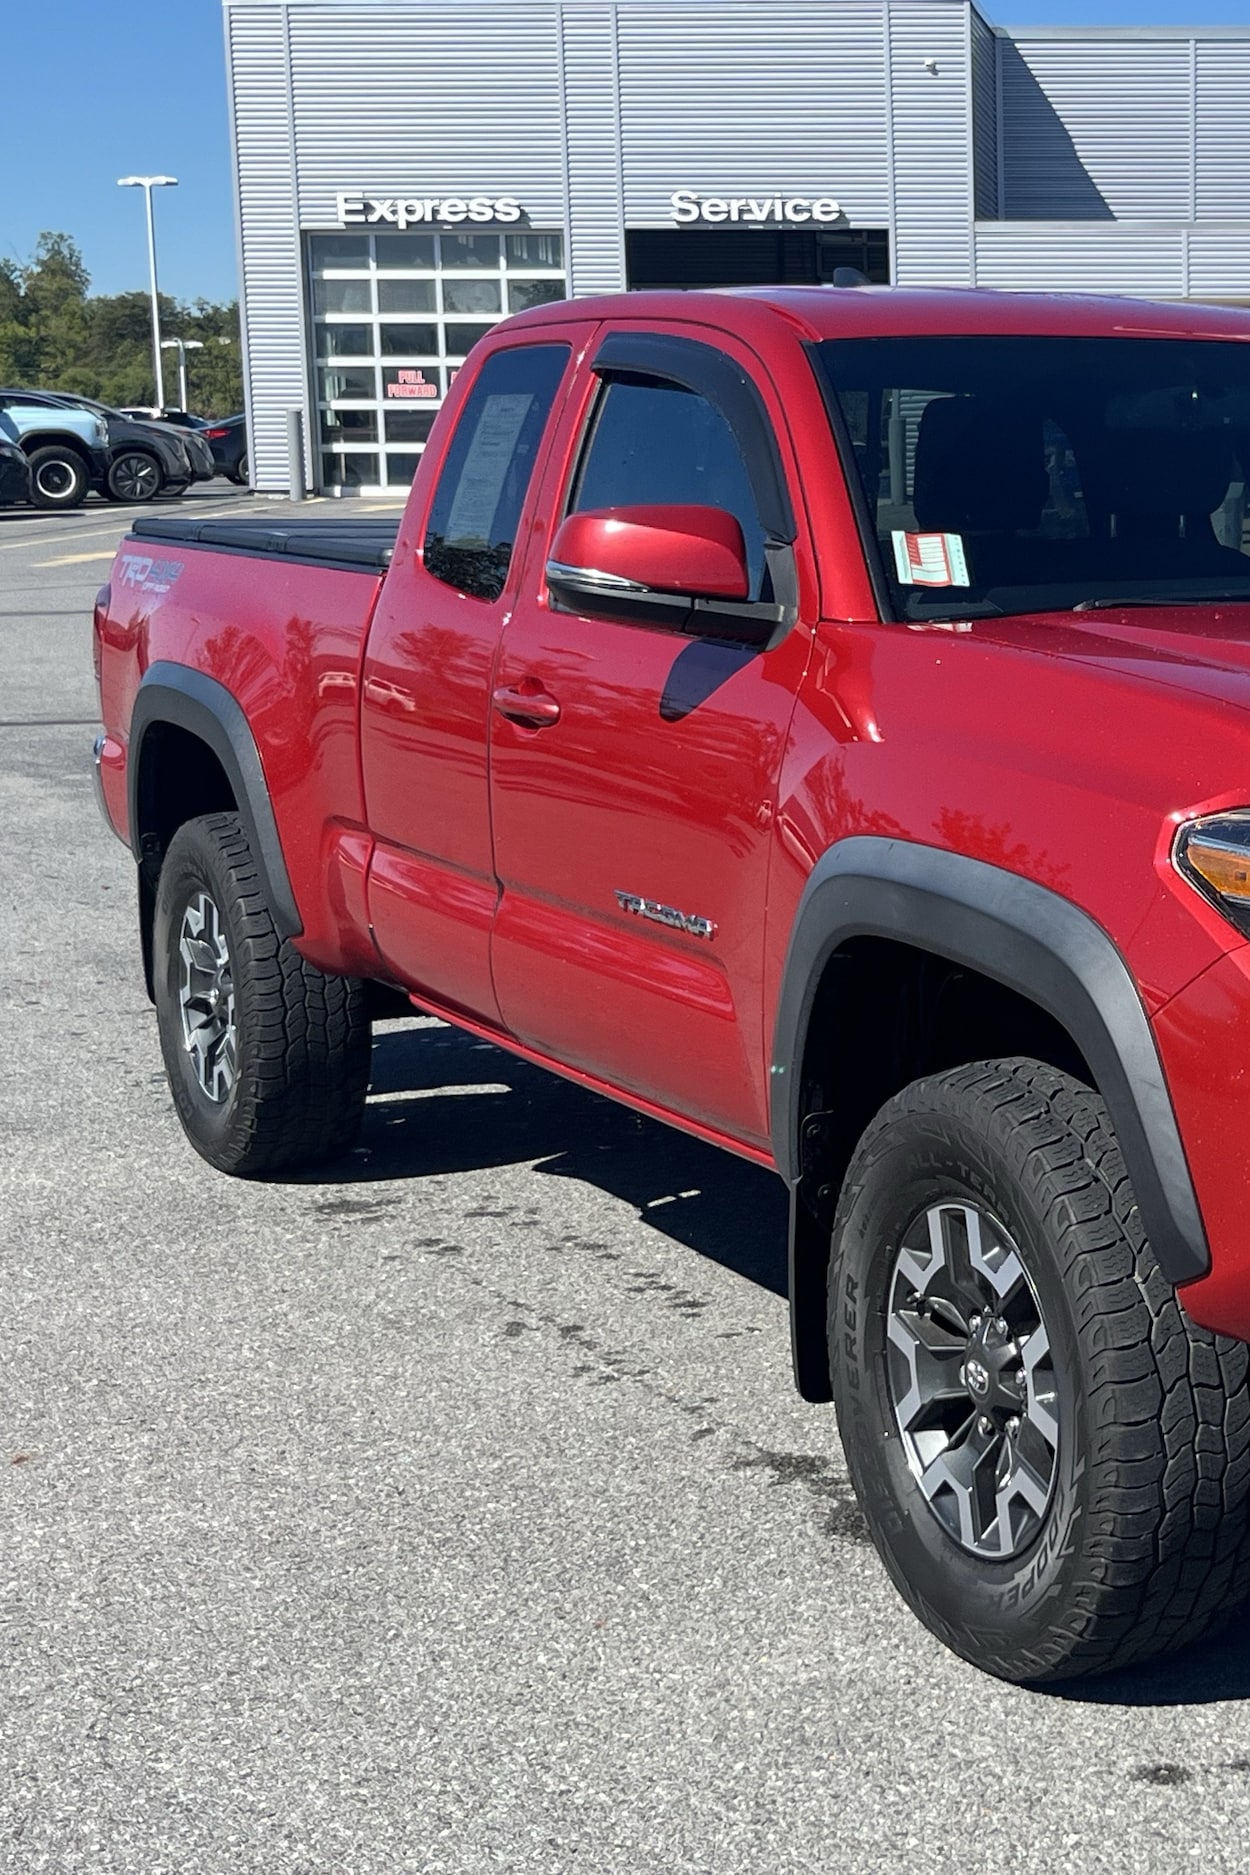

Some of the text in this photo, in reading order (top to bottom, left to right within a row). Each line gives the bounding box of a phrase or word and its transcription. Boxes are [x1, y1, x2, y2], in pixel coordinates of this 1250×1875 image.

[337, 191, 522, 230] Express
[670, 190, 841, 223] Service
[387, 384, 437, 398] FORWARD
[398, 370, 425, 384] PULL
[120, 554, 153, 588] TRD
[613, 889, 713, 938] TACOMA
